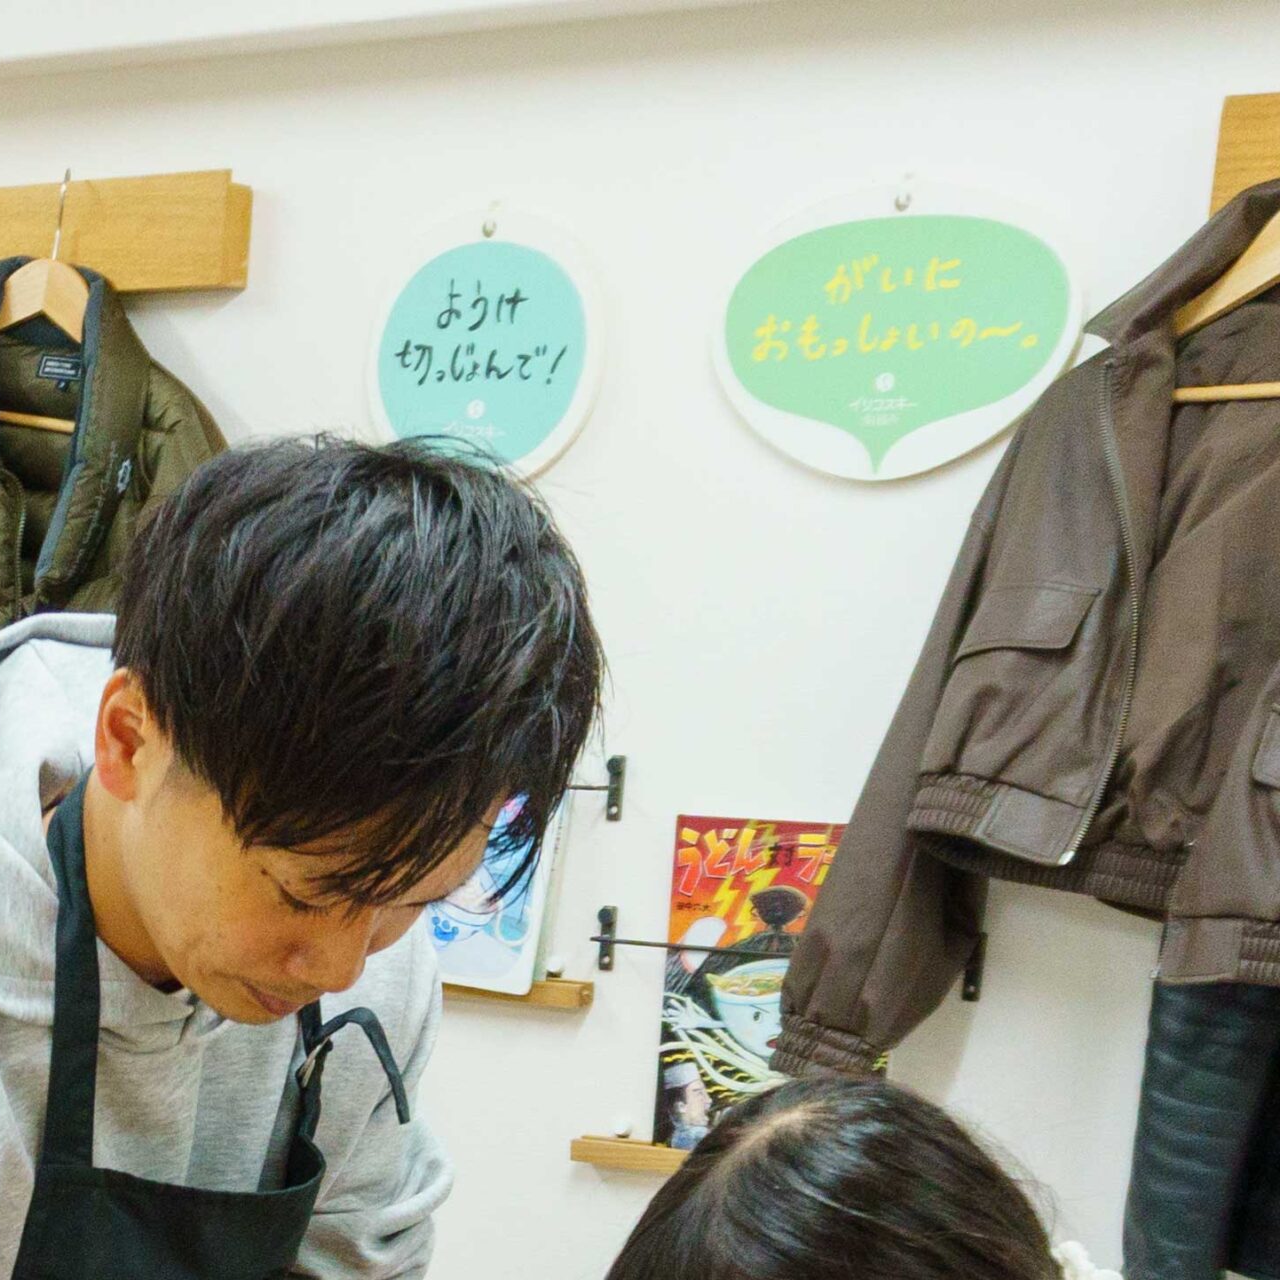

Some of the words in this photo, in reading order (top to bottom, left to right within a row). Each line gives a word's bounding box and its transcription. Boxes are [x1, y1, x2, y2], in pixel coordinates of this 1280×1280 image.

[436, 278, 529, 331] ようけ
[824, 253, 961, 304] がいに
